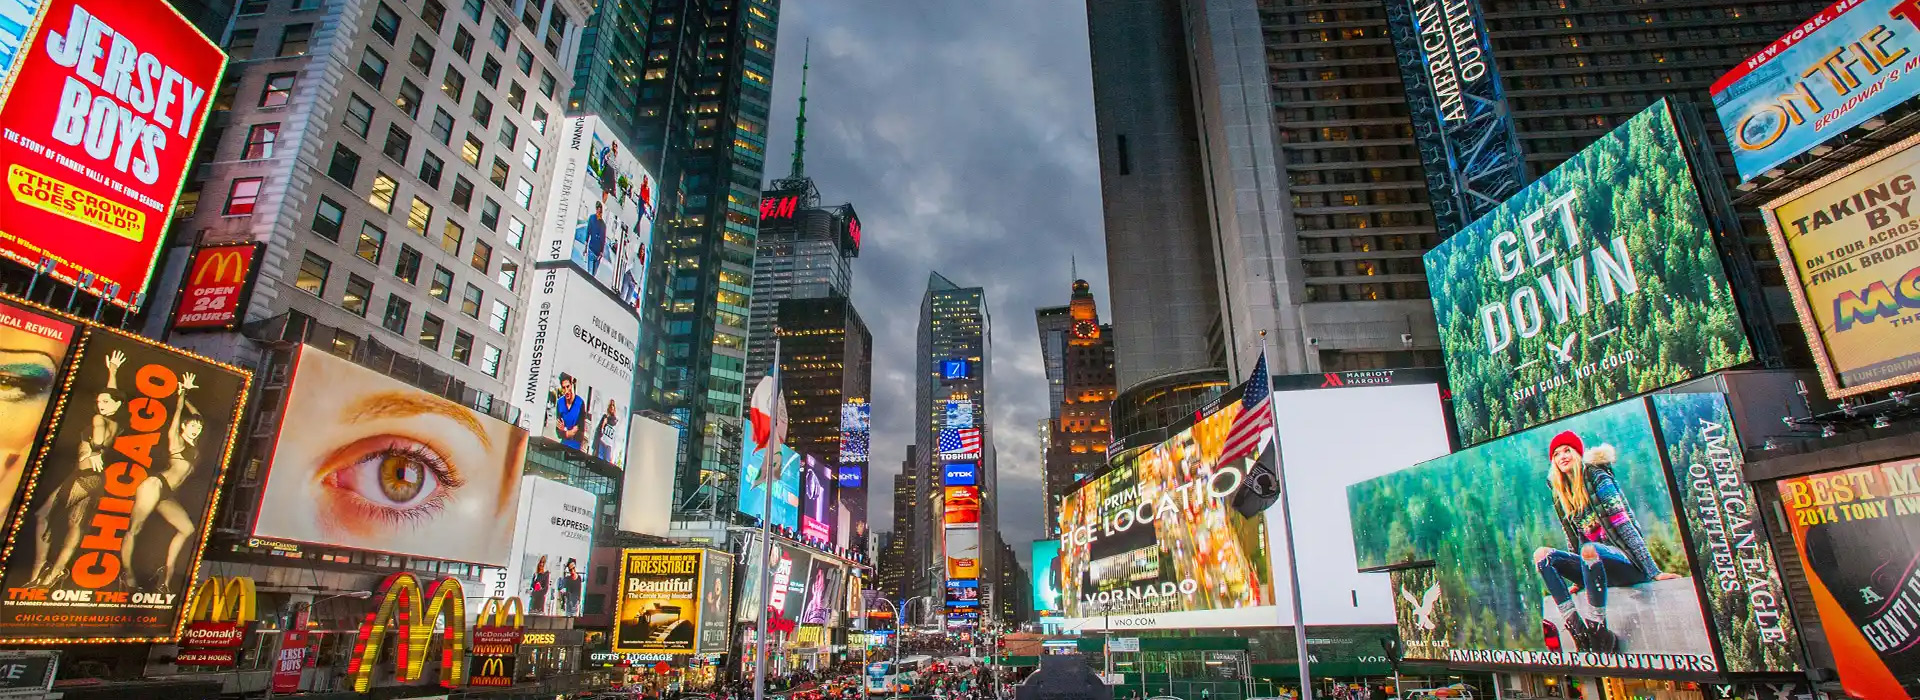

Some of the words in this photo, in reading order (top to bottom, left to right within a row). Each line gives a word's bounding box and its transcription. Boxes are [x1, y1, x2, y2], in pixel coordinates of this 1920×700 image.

[1748, 46, 1777, 70] NEW
[1781, 13, 1832, 46] YORK,
[46, 4, 205, 138] JERSEY
[1415, 2, 1468, 122] AMERICAN
[1735, 82, 1824, 150] ON
[1801, 25, 1911, 96] THE
[1814, 69, 1900, 132] BROADWAY'S
[52, 76, 166, 184] BOYS
[4, 128, 18, 143] THE
[20, 137, 45, 155] STORY
[46, 148, 55, 160] OF
[56, 154, 86, 174] FRANKIE
[85, 167, 104, 184] VALLI
[104, 176, 109, 187] &
[111, 180, 123, 192] THE
[123, 186, 139, 201] FOUR
[139, 193, 164, 213] SEASONS
[13, 168, 65, 195] “THE
[71, 190, 139, 223] CROWD
[17, 183, 76, 212] GOES
[83, 206, 141, 232] WILD!”
[1791, 174, 1917, 236] TAKING
[1864, 195, 1912, 231] BY
[1490, 188, 1582, 282] GET
[17, 237, 41, 253] Wilson
[70, 262, 83, 272] 245
[1806, 255, 1825, 270] ON
[1827, 239, 1865, 260] TOUR
[1811, 262, 1858, 286] FINAL
[1859, 238, 1920, 269] BROAD
[193, 296, 227, 311] 24
[194, 286, 235, 296] OPEN
[1480, 235, 1640, 355] DOWN
[0, 311, 22, 330] ICAL
[25, 321, 64, 341] REVIVAL
[180, 312, 232, 322] HOURS
[592, 315, 611, 335] FOLLOW
[525, 301, 551, 404] @EXPRESSRUNWAY
[951, 362, 960, 374] 7
[1346, 370, 1394, 378] MARRIOTT
[1347, 377, 1390, 385] MARQUIS
[1513, 385, 1537, 401] STAY
[1539, 374, 1571, 393] COOL.
[1575, 362, 1598, 379] NOT
[1602, 349, 1640, 370] COLD.
[71, 363, 178, 589] CHICAGO
[1787, 470, 1875, 508] BEST
[1060, 522, 1098, 552] FICE
[1104, 457, 1256, 537] LOCATIO
[1104, 481, 1145, 514] PRIME
[1796, 506, 1838, 526] 2014
[1840, 499, 1889, 521] TONY
[1688, 463, 1741, 592] OUTFITTERS
[1698, 418, 1759, 550] AMERICAN
[1739, 553, 1788, 643] EAGLE
[7, 588, 49, 600] THE
[51, 590, 93, 601] ONE
[95, 591, 129, 603] THE
[132, 592, 176, 605] ONLY
[629, 578, 693, 592] Beautiful
[1085, 578, 1198, 606] VORNADO
[1859, 586, 1884, 605] A
[15, 613, 158, 623] CHICAGOTHEMUSICAL.COM
[184, 626, 243, 639] McDonald's
[1114, 618, 1156, 627] VNO.COM
[208, 654, 232, 662] HOURS
[280, 648, 306, 660] JERSEY
[591, 653, 619, 661] GIFTS
[626, 653, 672, 662] LUGGAGE
[1406, 639, 1428, 647] GREAT
[281, 659, 301, 672] BOYS
[1450, 649, 1525, 665] AMERICAN
[1529, 651, 1581, 667] EAGLE
[1583, 652, 1717, 672] OUTFITTERS
